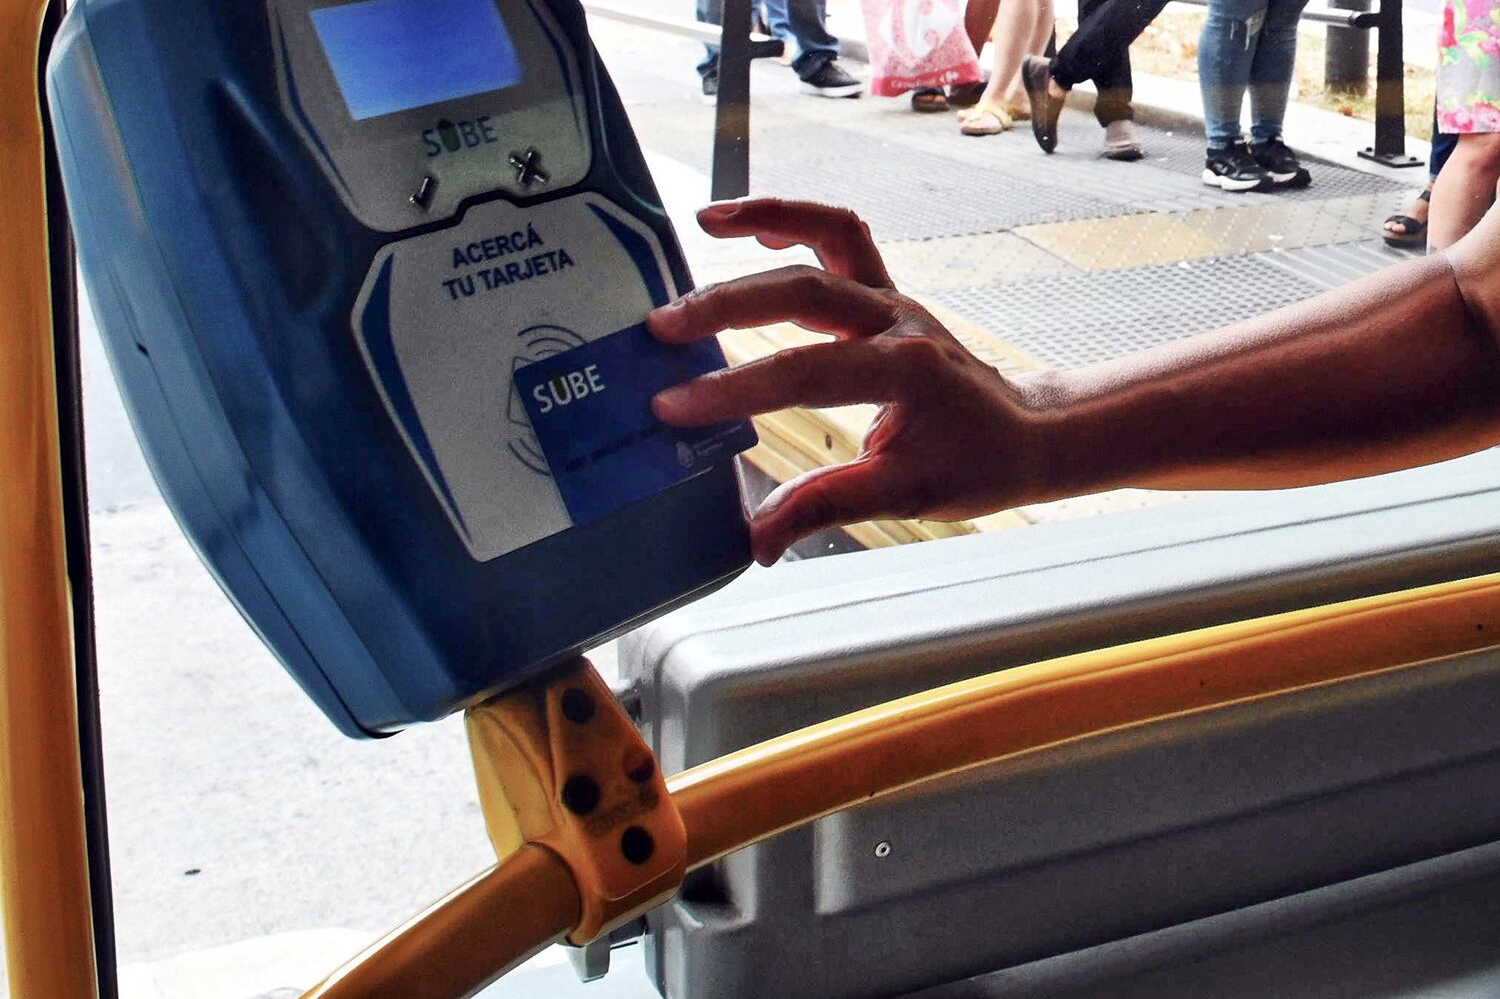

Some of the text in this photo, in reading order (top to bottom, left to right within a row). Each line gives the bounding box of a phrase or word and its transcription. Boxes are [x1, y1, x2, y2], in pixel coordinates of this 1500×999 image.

[422, 116, 498, 157] SUBE
[452, 221, 544, 269] ACERCÁ
[442, 248, 575, 301] TU TARJETA
[532, 364, 606, 414] SUBE
